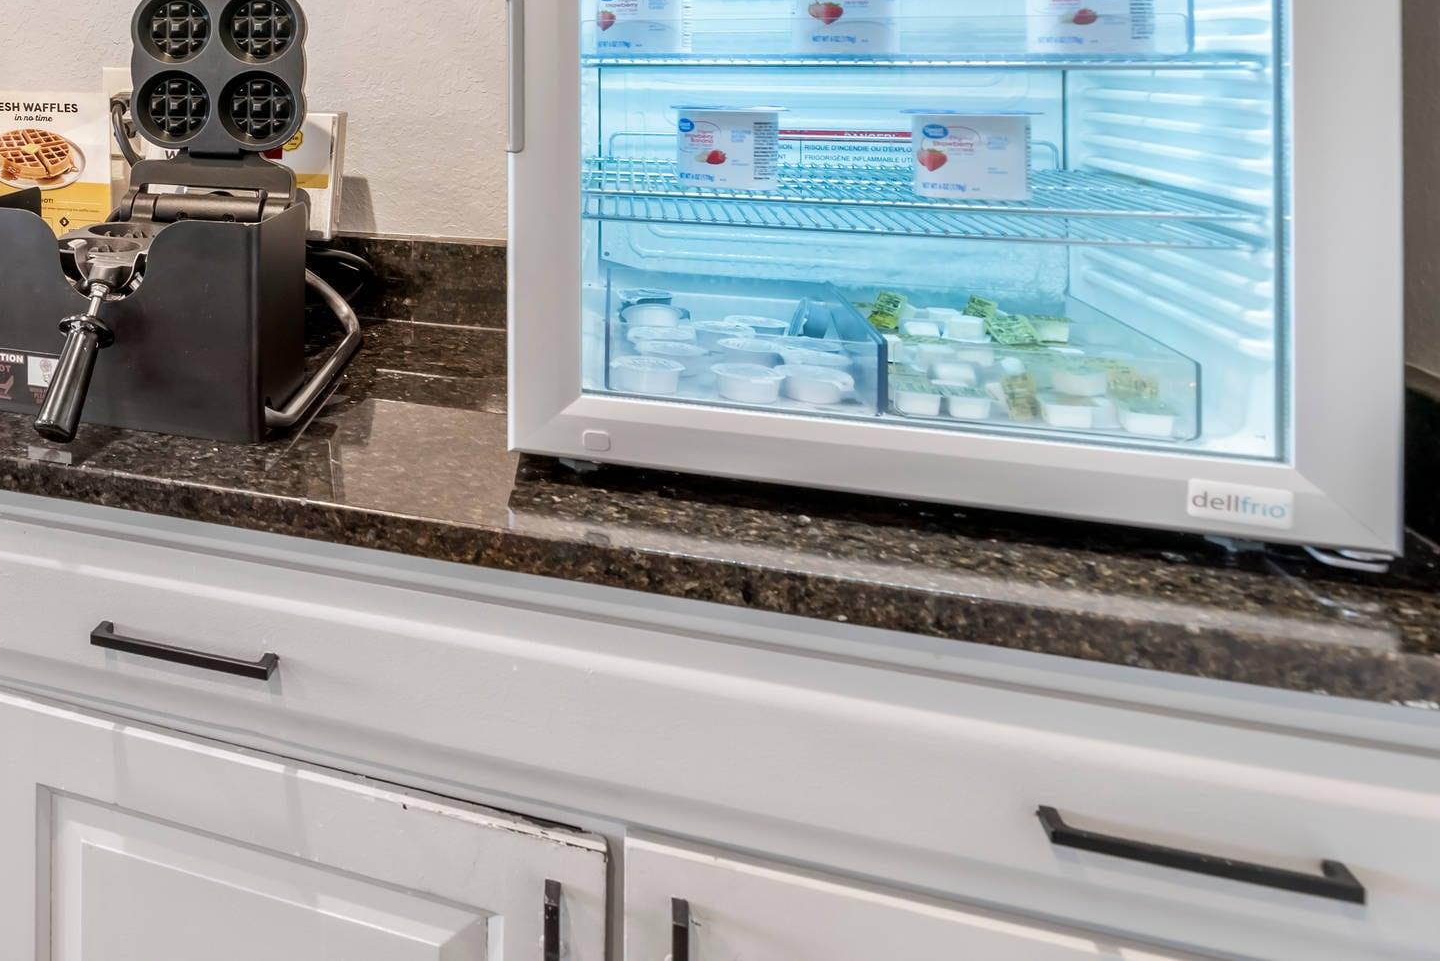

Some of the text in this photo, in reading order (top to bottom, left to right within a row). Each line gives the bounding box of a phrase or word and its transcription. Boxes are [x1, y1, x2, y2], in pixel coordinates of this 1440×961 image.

[23, 102, 79, 114] WAFFLES
[35, 114, 53, 122] time
[1192, 491, 1286, 519] dellfrio
